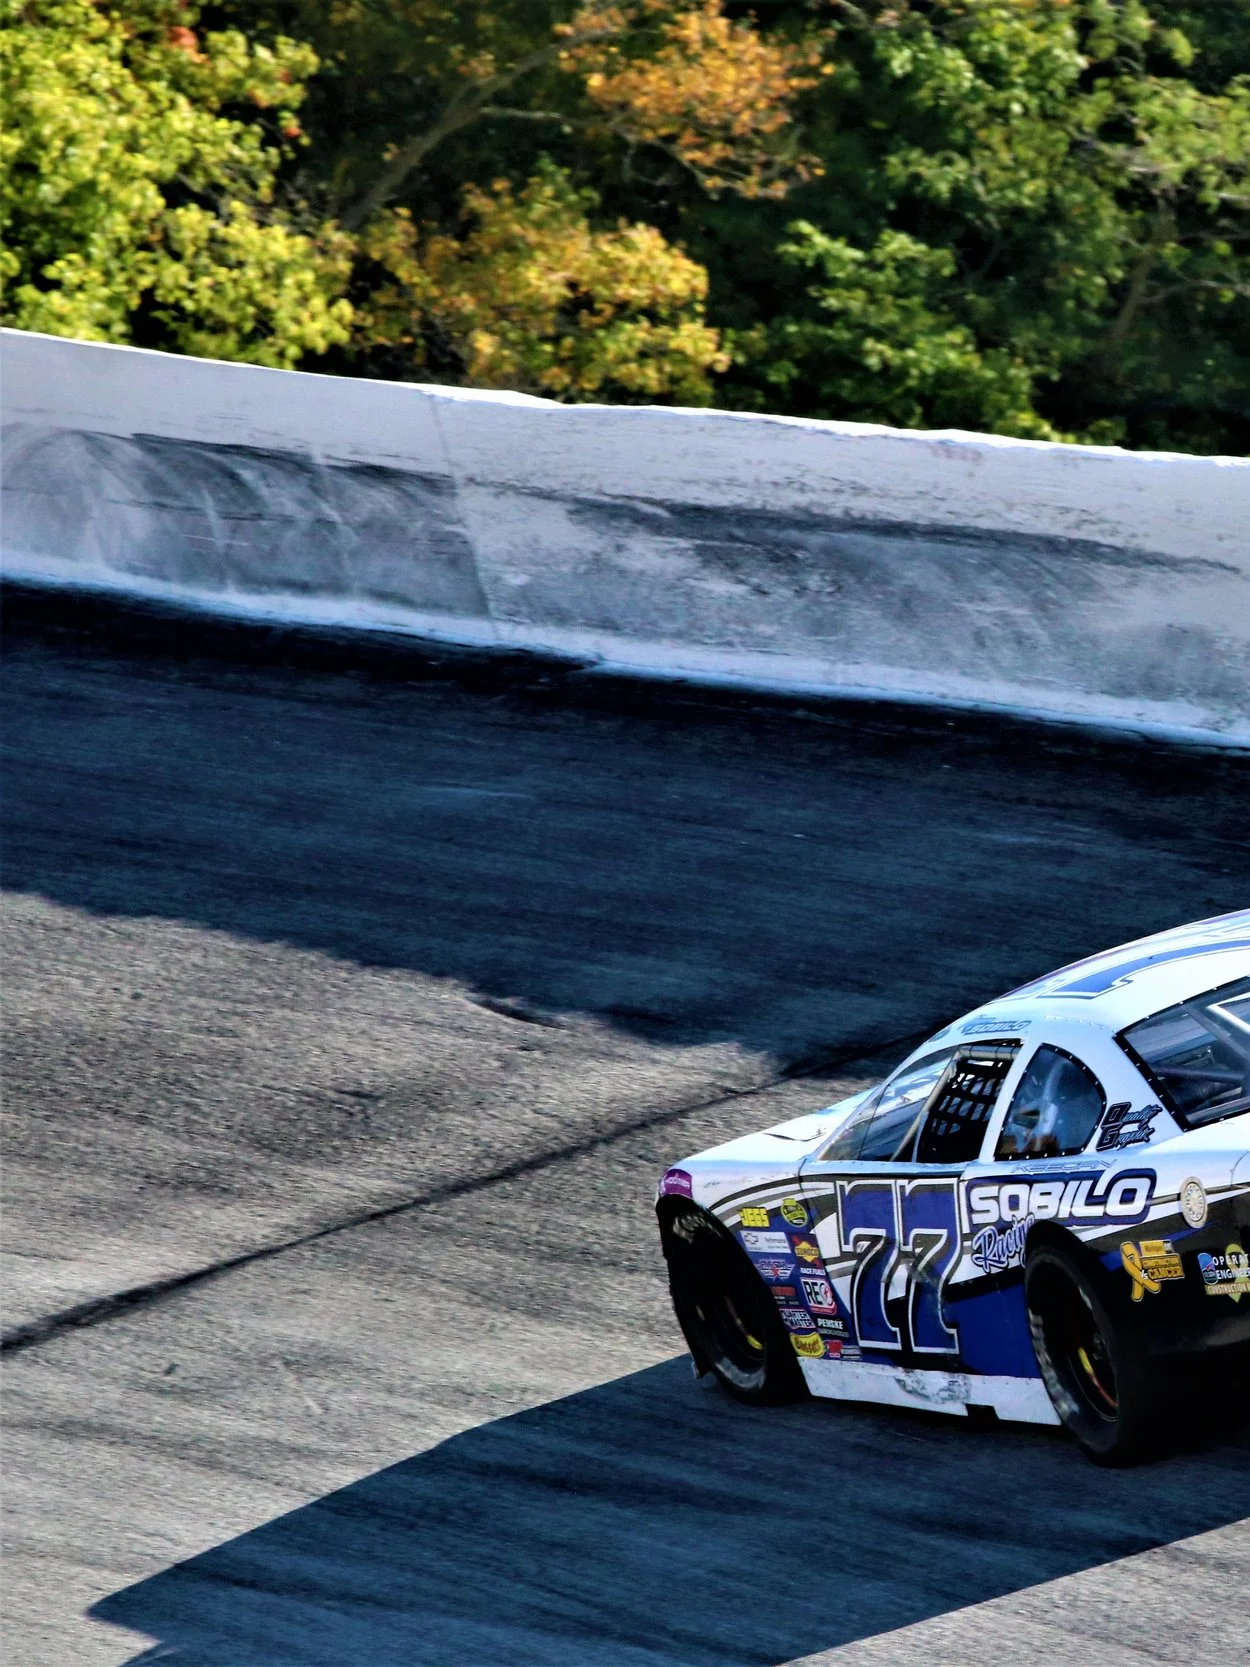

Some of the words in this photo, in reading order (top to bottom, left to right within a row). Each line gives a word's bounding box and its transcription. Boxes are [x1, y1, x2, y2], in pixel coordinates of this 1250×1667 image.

[969, 1175, 1152, 1226] SOBILO
[835, 1177, 960, 1355] 77
[817, 1318, 844, 1330] PENSKE
